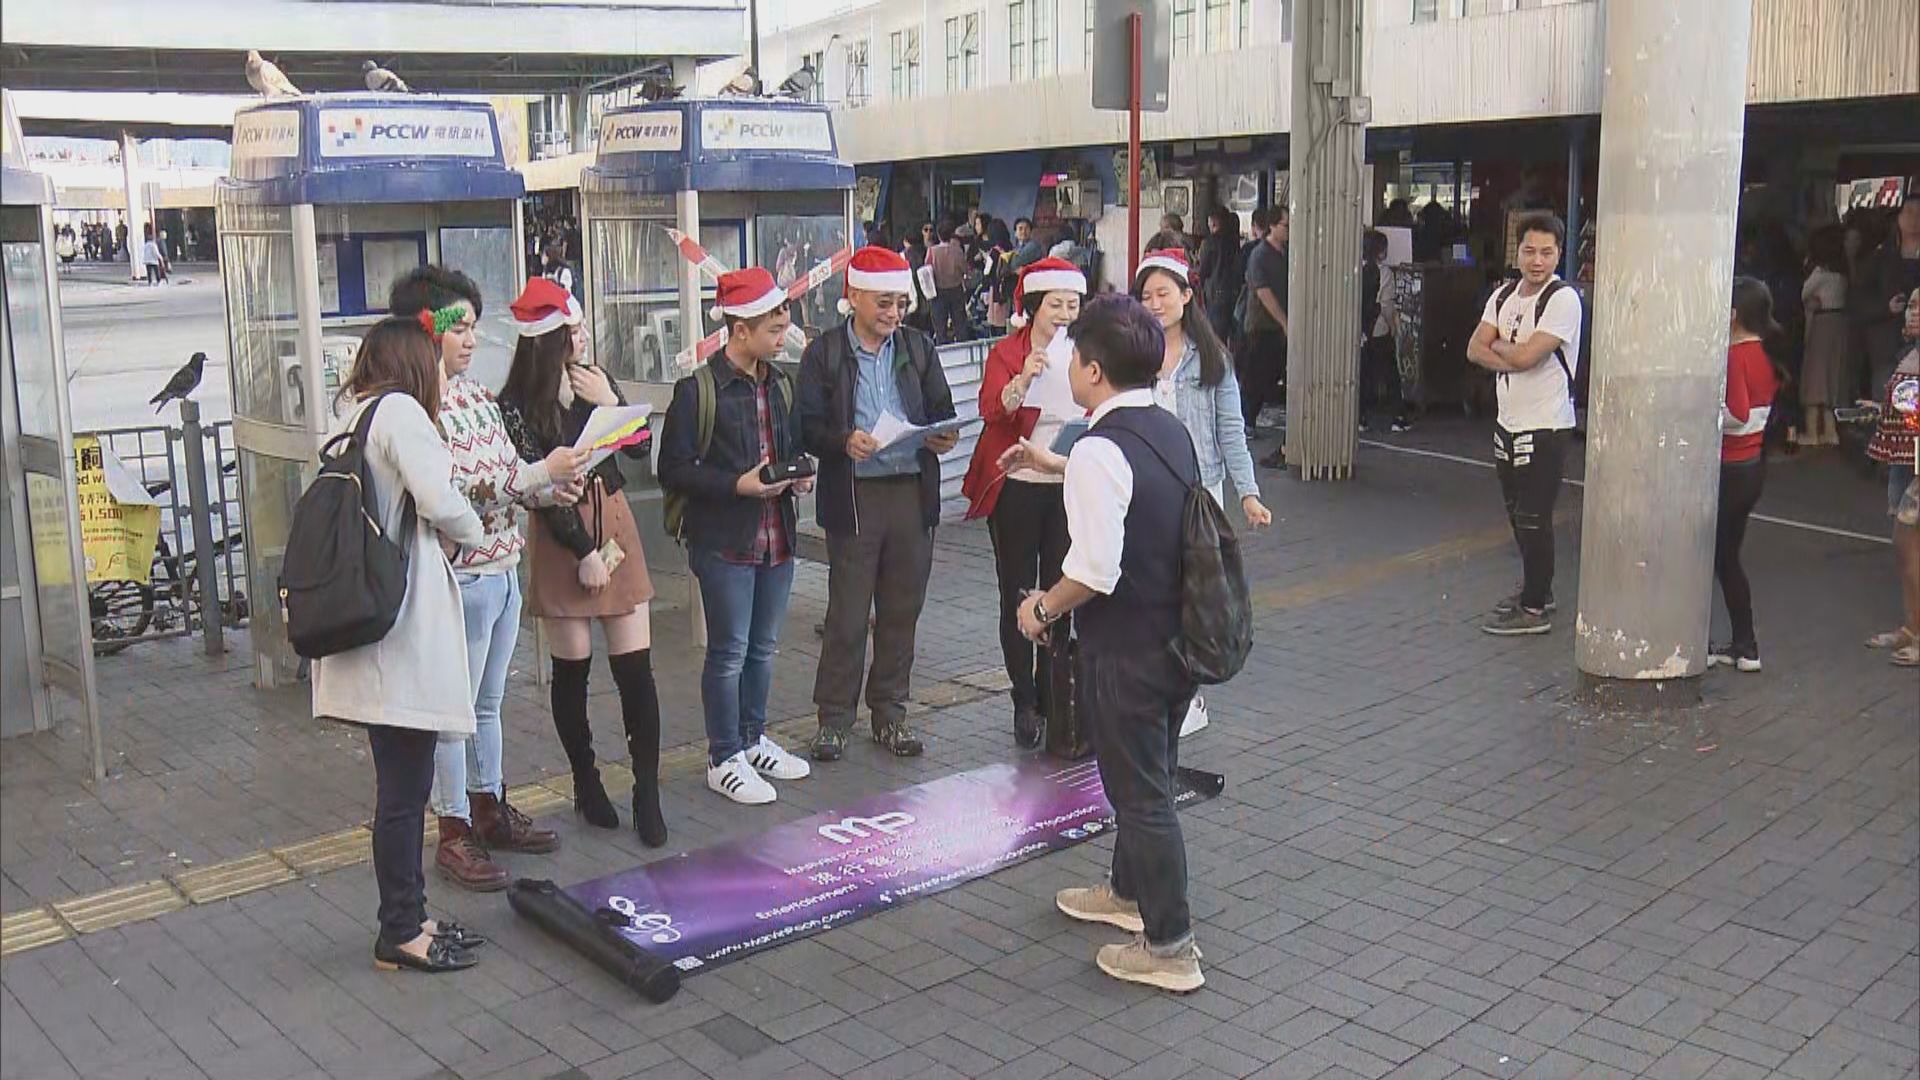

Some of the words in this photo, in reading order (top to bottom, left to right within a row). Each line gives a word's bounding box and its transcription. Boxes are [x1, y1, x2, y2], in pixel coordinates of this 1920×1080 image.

[370, 124, 429, 139] PCCW
[616, 126, 643, 140] PCCW
[740, 124, 783, 137] PCCW
